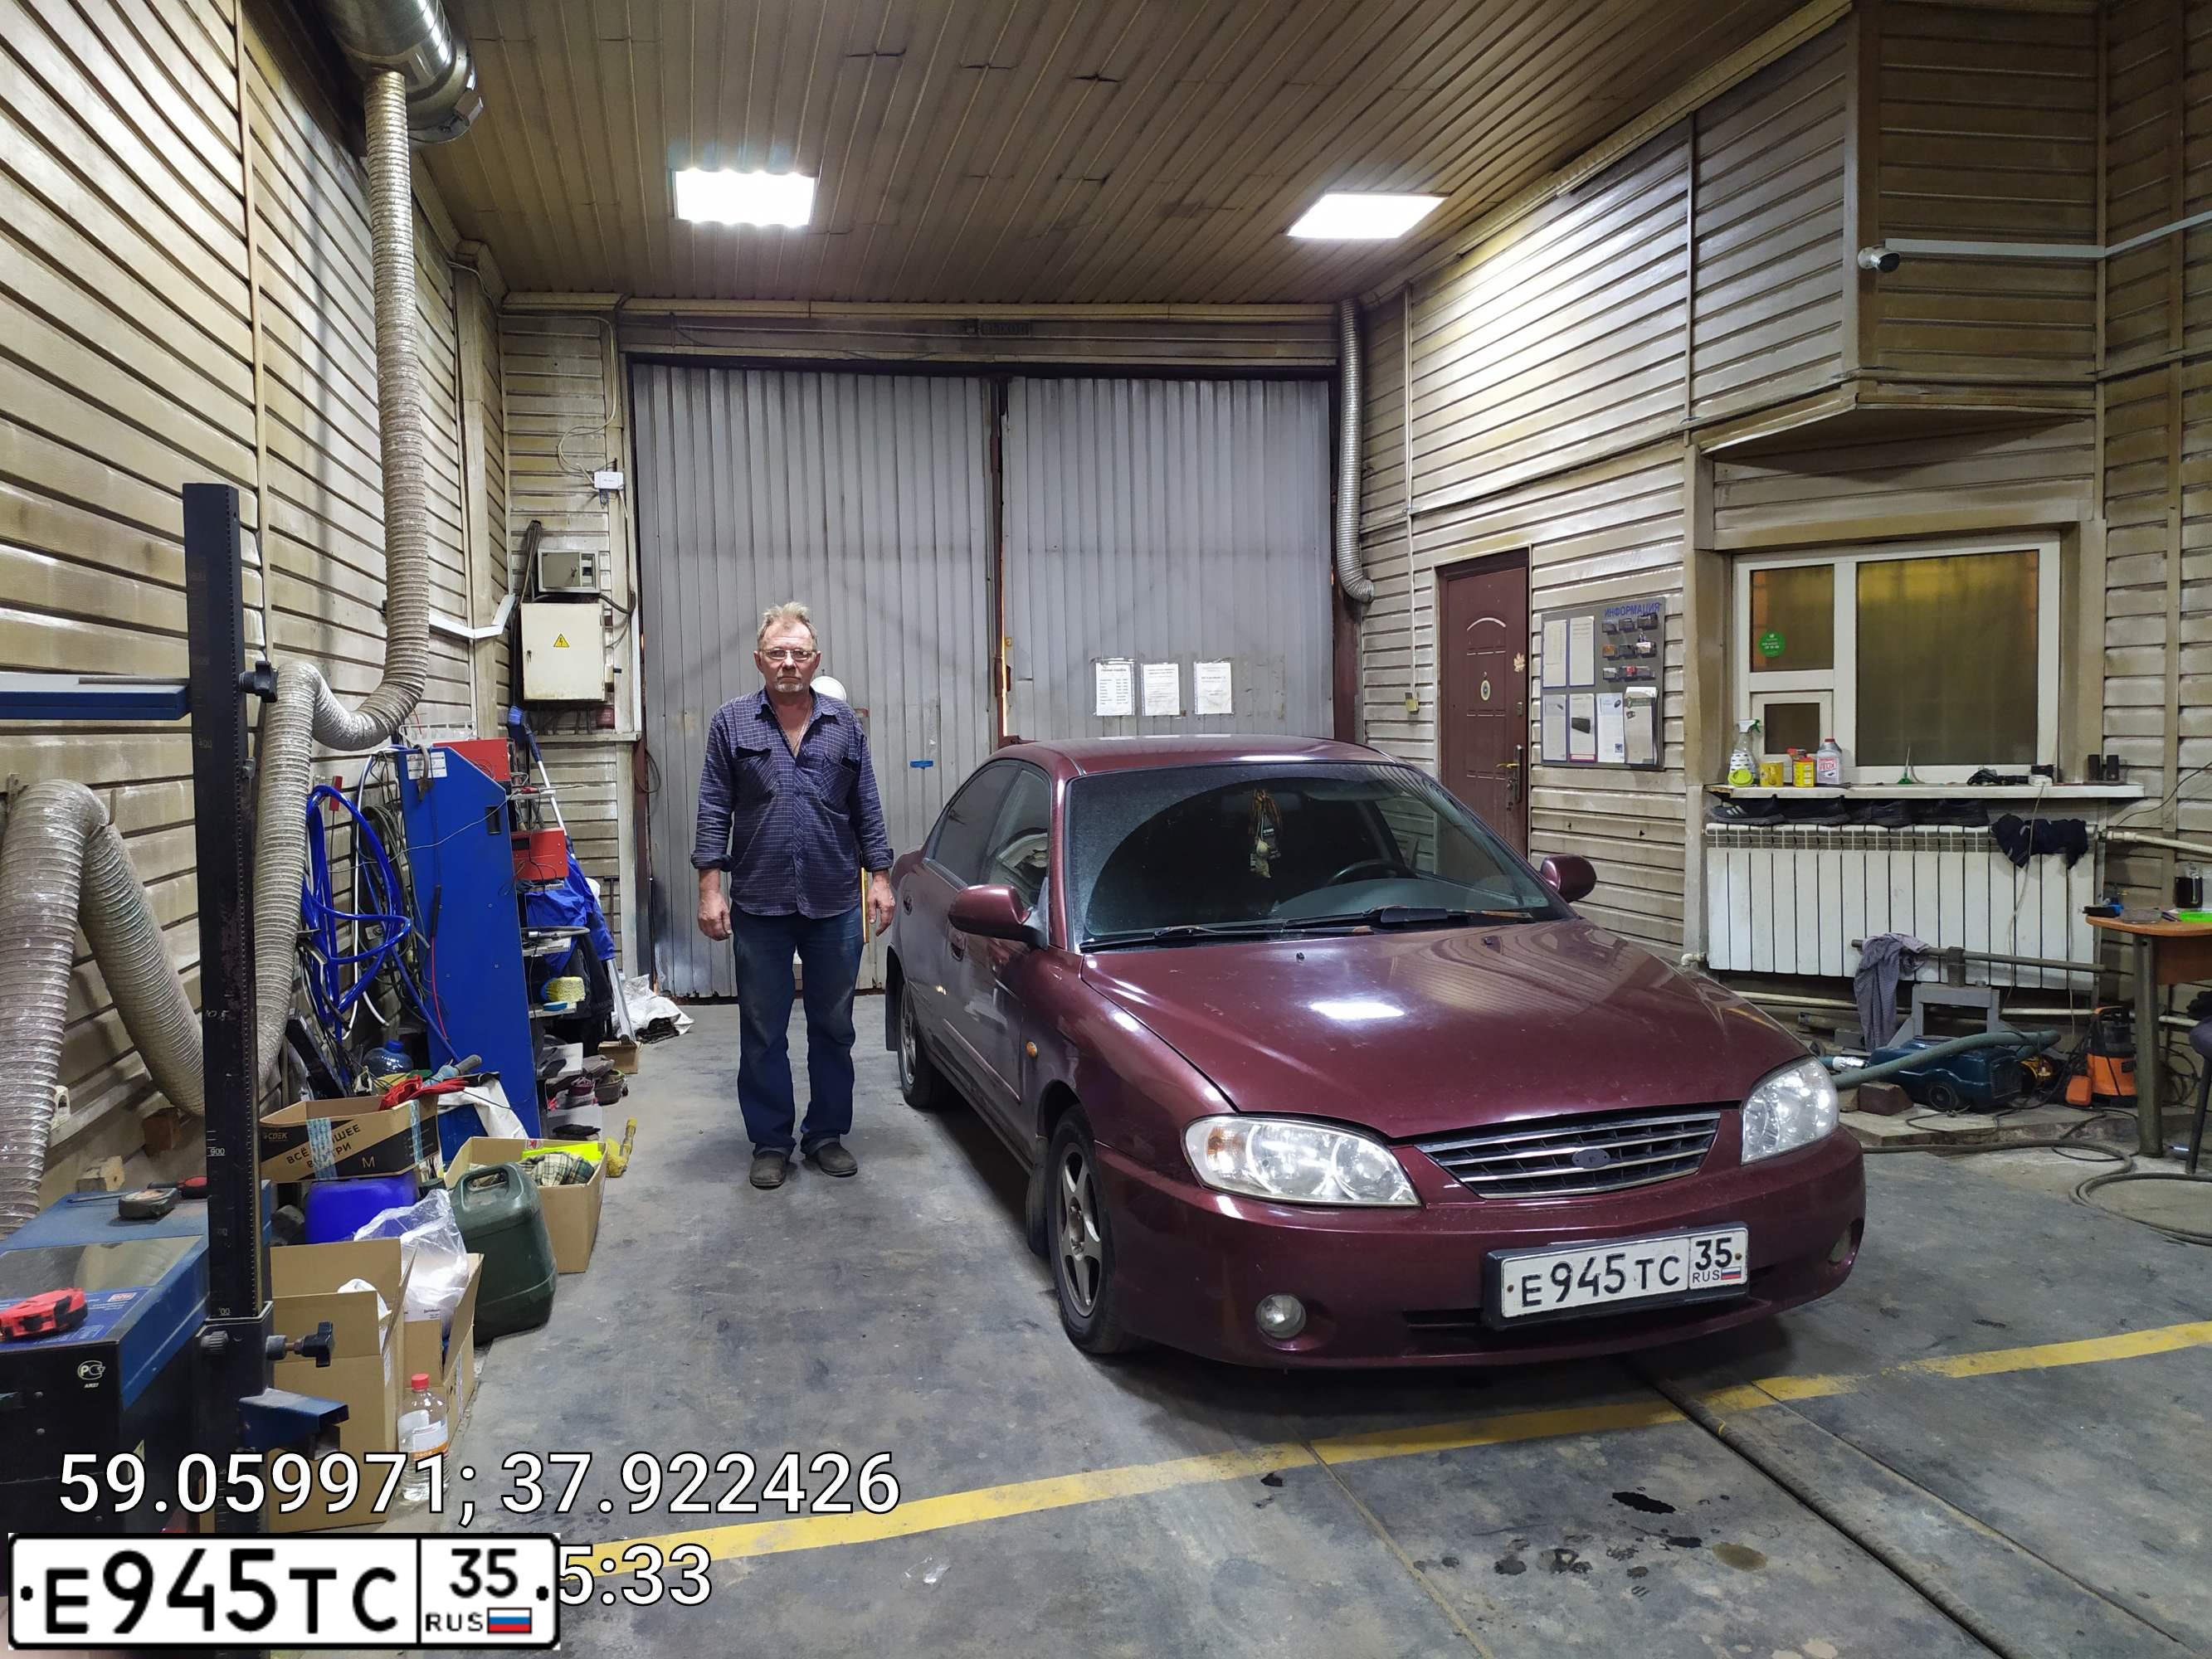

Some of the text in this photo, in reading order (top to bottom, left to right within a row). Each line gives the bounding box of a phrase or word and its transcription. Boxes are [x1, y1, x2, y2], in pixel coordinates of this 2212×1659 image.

[1605, 602, 1660, 617] ИНФОРМАЦИЯ
[210, 1148, 226, 1156] 900
[285, 1147, 310, 1165] ВСЁ
[362, 1155, 376, 1168] M
[1694, 1237, 1733, 1272] 35
[1692, 1269, 1721, 1284] RUS
